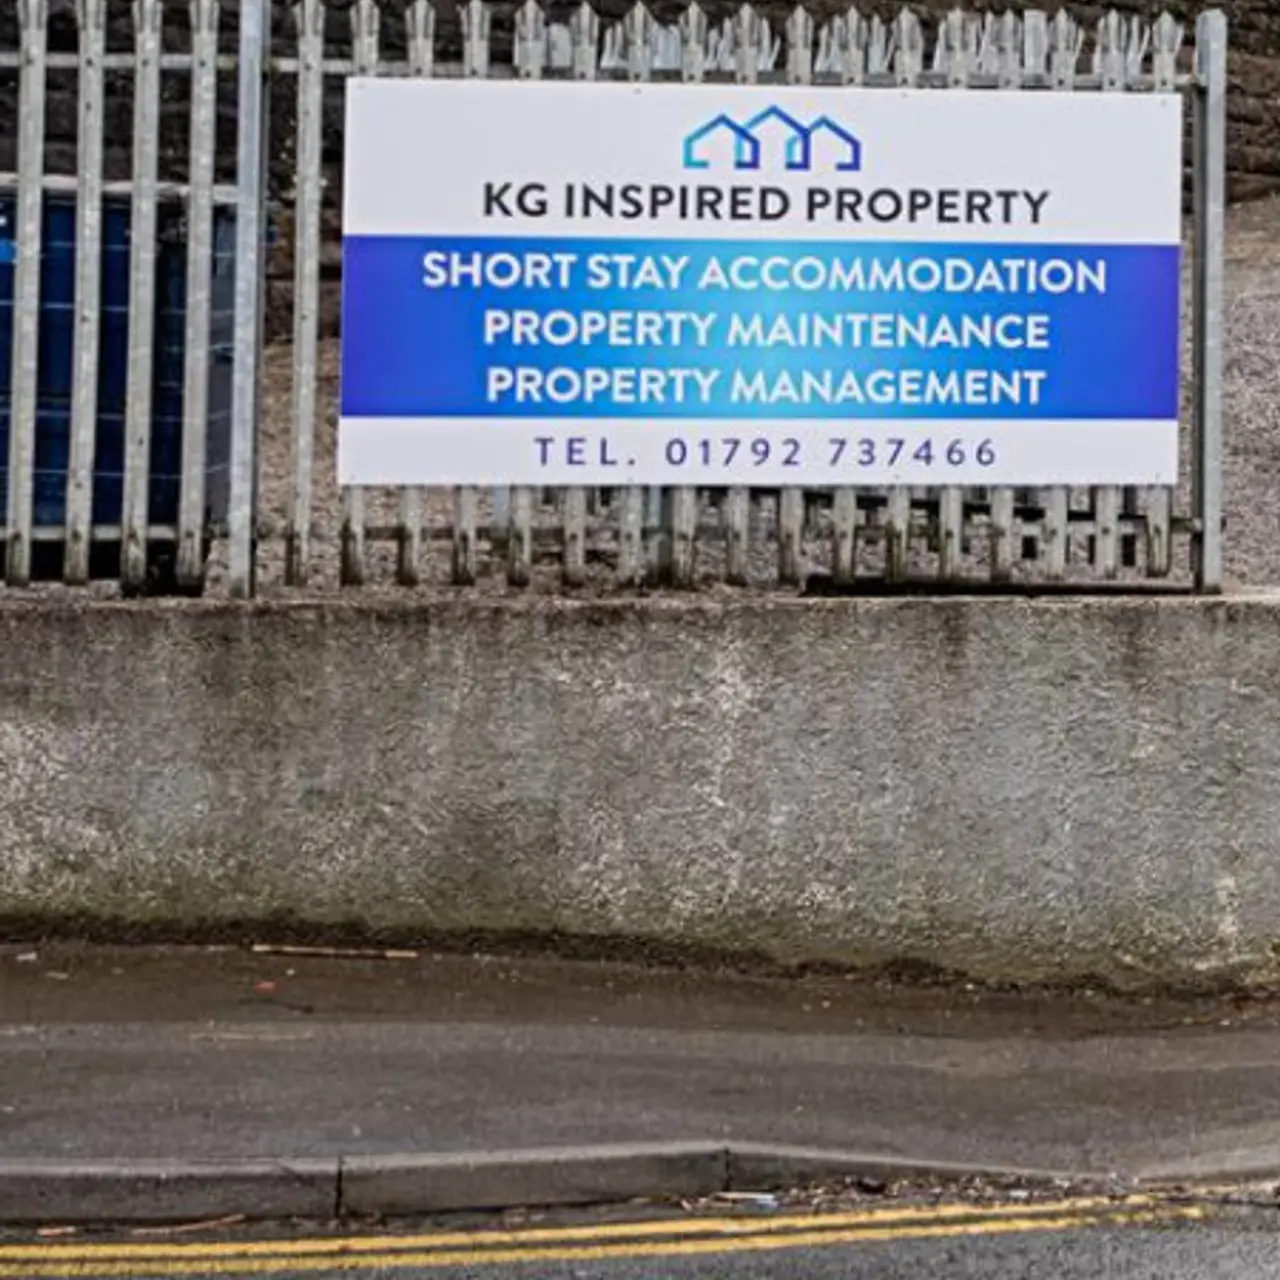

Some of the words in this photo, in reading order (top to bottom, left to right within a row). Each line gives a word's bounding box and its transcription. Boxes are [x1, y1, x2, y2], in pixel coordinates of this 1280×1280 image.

[484, 182, 548, 219] KG
[564, 183, 790, 222] INSPIRED
[806, 187, 1049, 225] PROPERTY
[422, 251, 576, 288] SHORT
[587, 254, 689, 290] STAY
[699, 255, 1106, 294] ACCOMMODATION
[484, 309, 716, 347] PROPERTY
[727, 312, 1049, 349] MAINTENANCE
[487, 367, 719, 404] PROPERTY
[730, 369, 1046, 405] MANAGEMENT
[534, 436, 637, 467] TEL.
[664, 437, 802, 467] 01792
[829, 437, 997, 468] 737466
